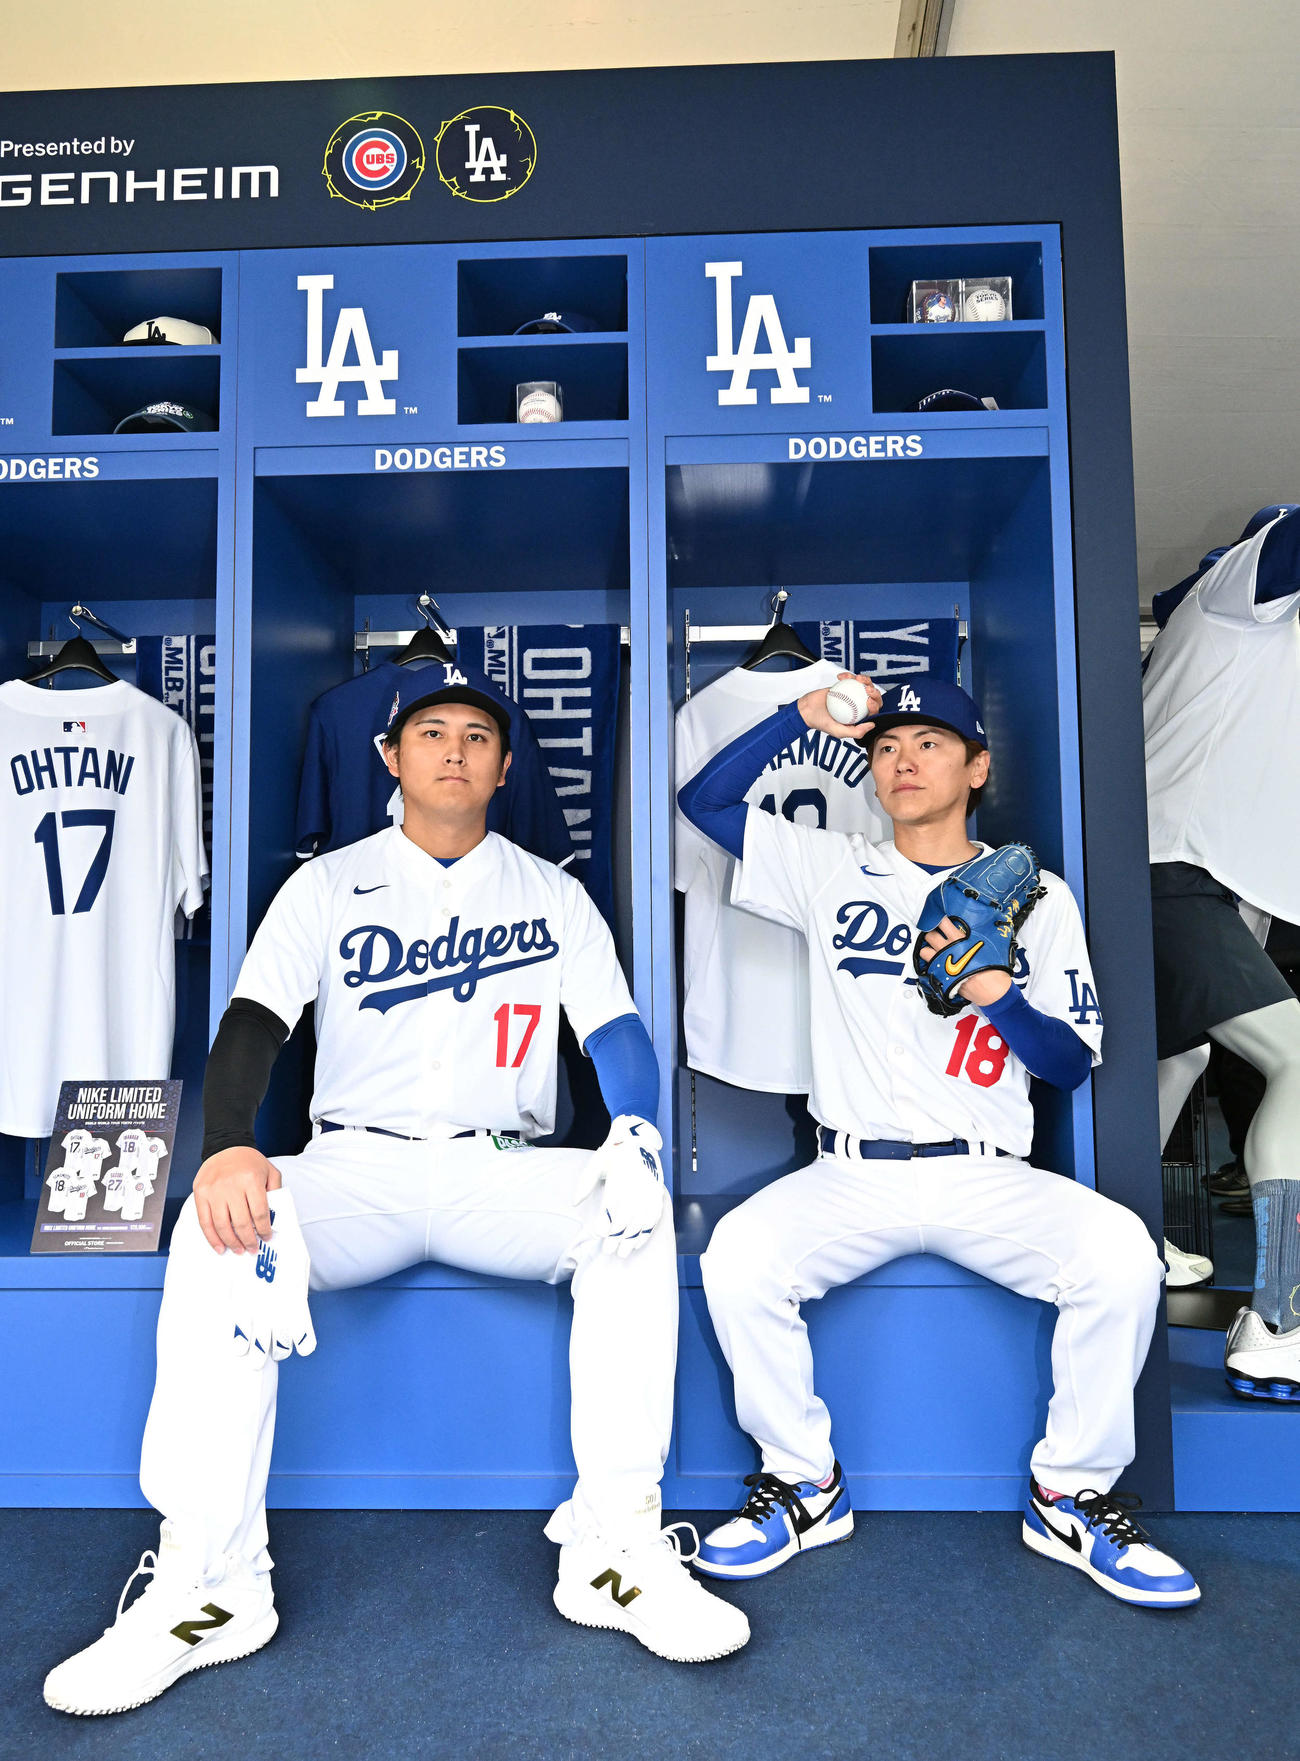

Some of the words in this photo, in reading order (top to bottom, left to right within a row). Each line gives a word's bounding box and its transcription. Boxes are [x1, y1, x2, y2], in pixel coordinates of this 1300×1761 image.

[0, 137, 106, 158] Presented
[110, 136, 136, 156] by
[464, 124, 507, 183] LA
[295, 274, 399, 418] LA
[704, 261, 812, 406] LA
[374, 445, 507, 471] DODGERS
[788, 434, 924, 460] DODGERS
[442, 663, 469, 686] LA
[897, 684, 921, 712] LA
[10, 746, 135, 797] OHTANI
[33, 808, 117, 916] 17
[339, 915, 560, 1004] Dodgers
[1063, 968, 1105, 1025] LA
[494, 1003, 542, 1068] 17
[945, 1013, 1010, 1089] 18
[77, 1088, 108, 1103] NIKE
[110, 1087, 162, 1102] LIMITED
[68, 1104, 126, 1119] UNIFORM
[129, 1103, 166, 1118] HOME
[70, 1141, 81, 1154] 17
[122, 1142, 135, 1152] 18
[54, 1180, 65, 1192] 18
[107, 1179, 123, 1191] 27
